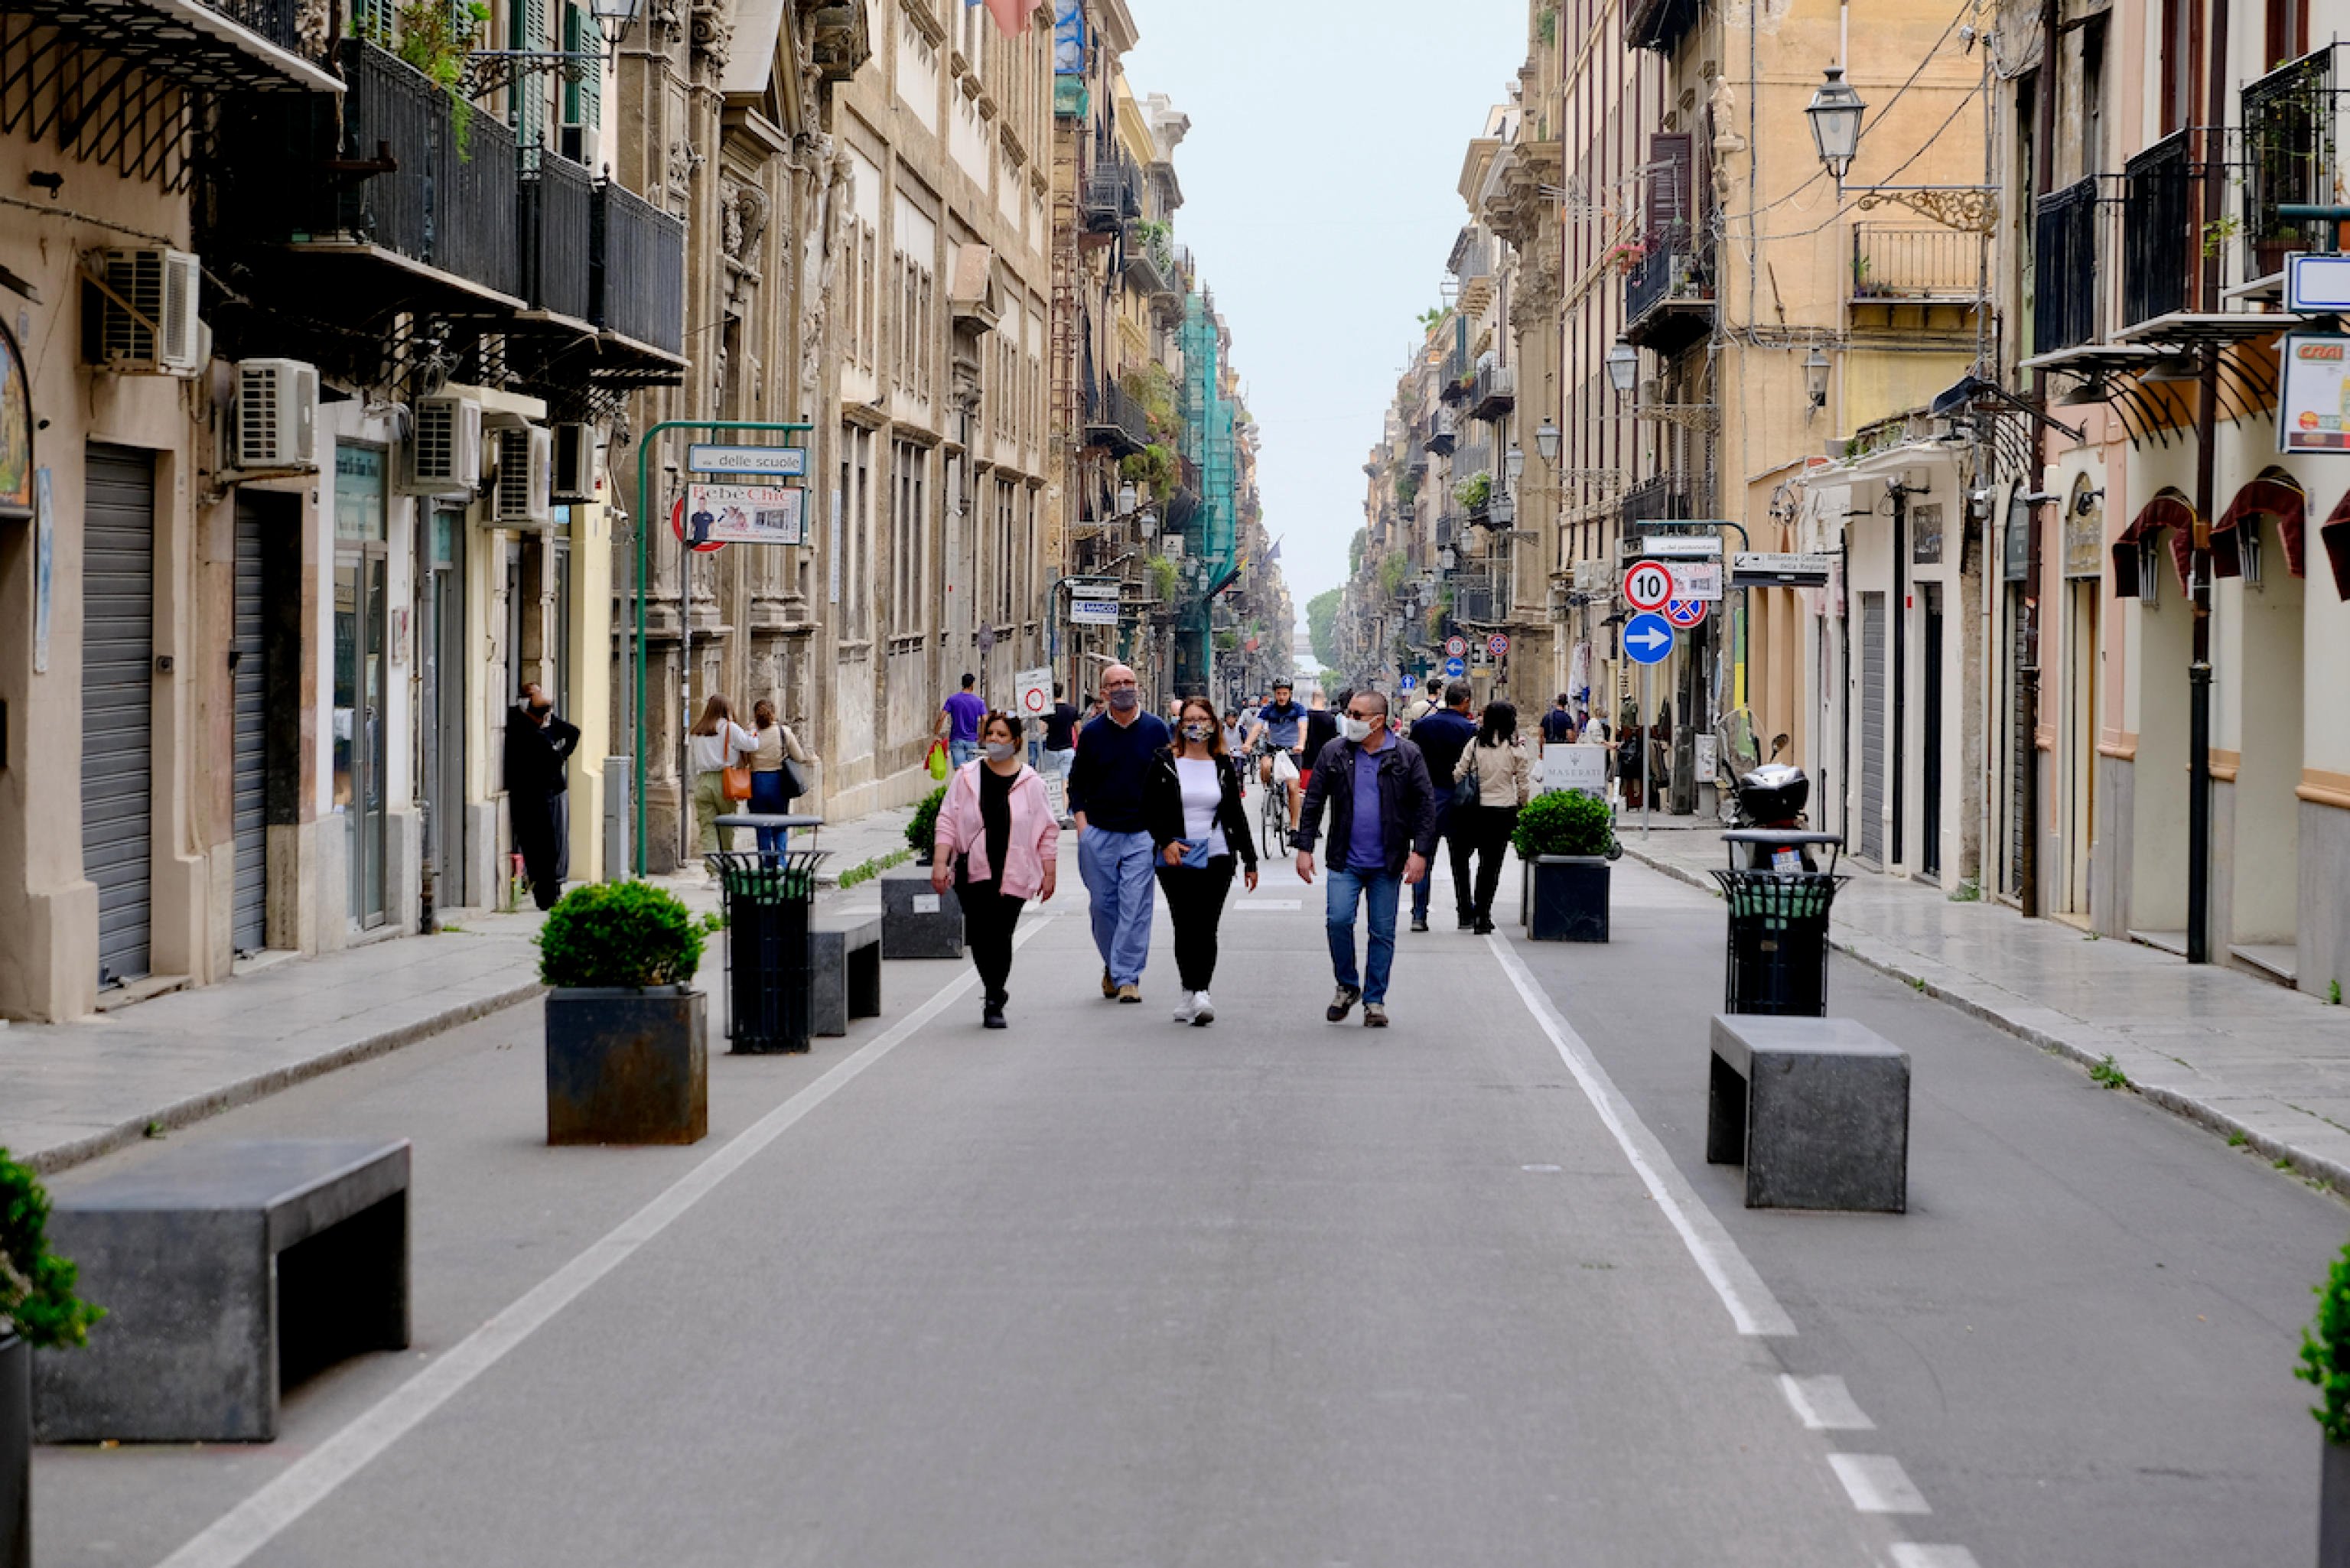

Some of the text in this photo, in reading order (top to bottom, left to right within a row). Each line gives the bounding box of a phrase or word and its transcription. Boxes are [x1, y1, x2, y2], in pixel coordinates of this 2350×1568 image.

[719, 455, 751, 467] delle
[756, 457, 799, 469] scuole
[1637, 575, 1661, 597] 10
[1548, 769, 1602, 777] MASERATI
